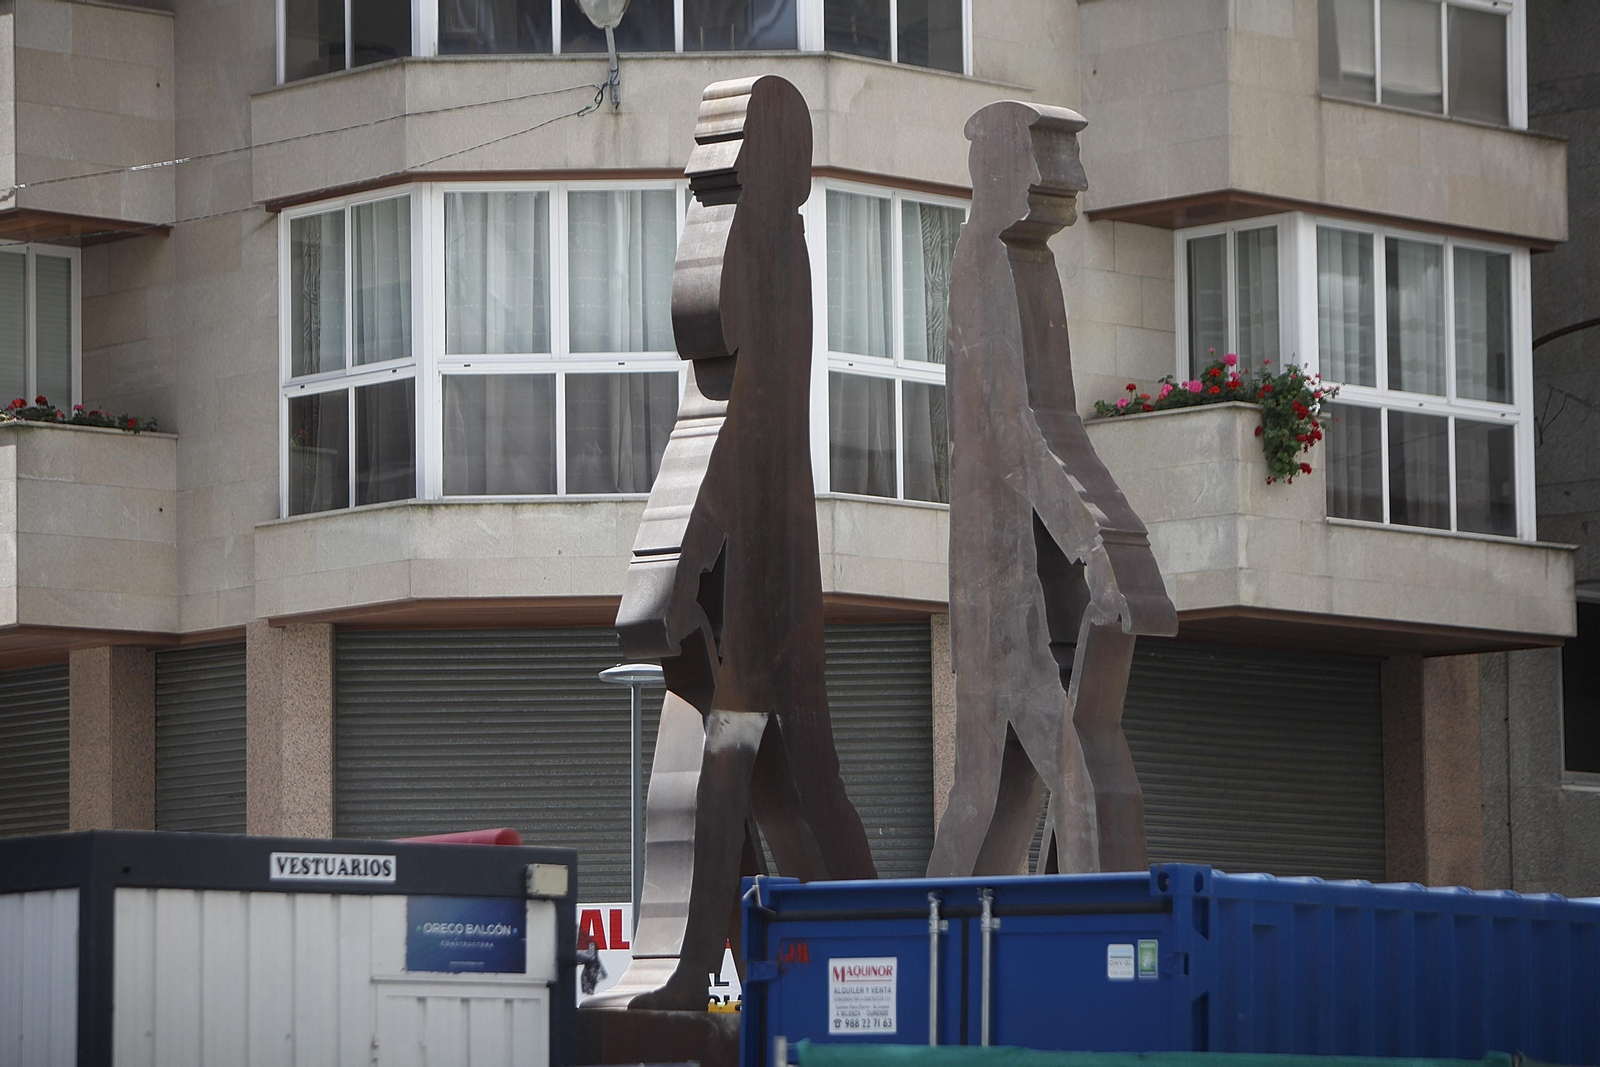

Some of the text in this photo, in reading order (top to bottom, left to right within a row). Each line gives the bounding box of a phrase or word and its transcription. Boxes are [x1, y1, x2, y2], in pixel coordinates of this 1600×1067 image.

[276, 856, 392, 877] VESTUARIOS
[423, 922, 464, 935] ORECO
[833, 964, 893, 983] MAQUINOR
[833, 986, 892, 995] ALQUILER Y VENTA
[845, 1018, 893, 1028] 988 22 71 63
